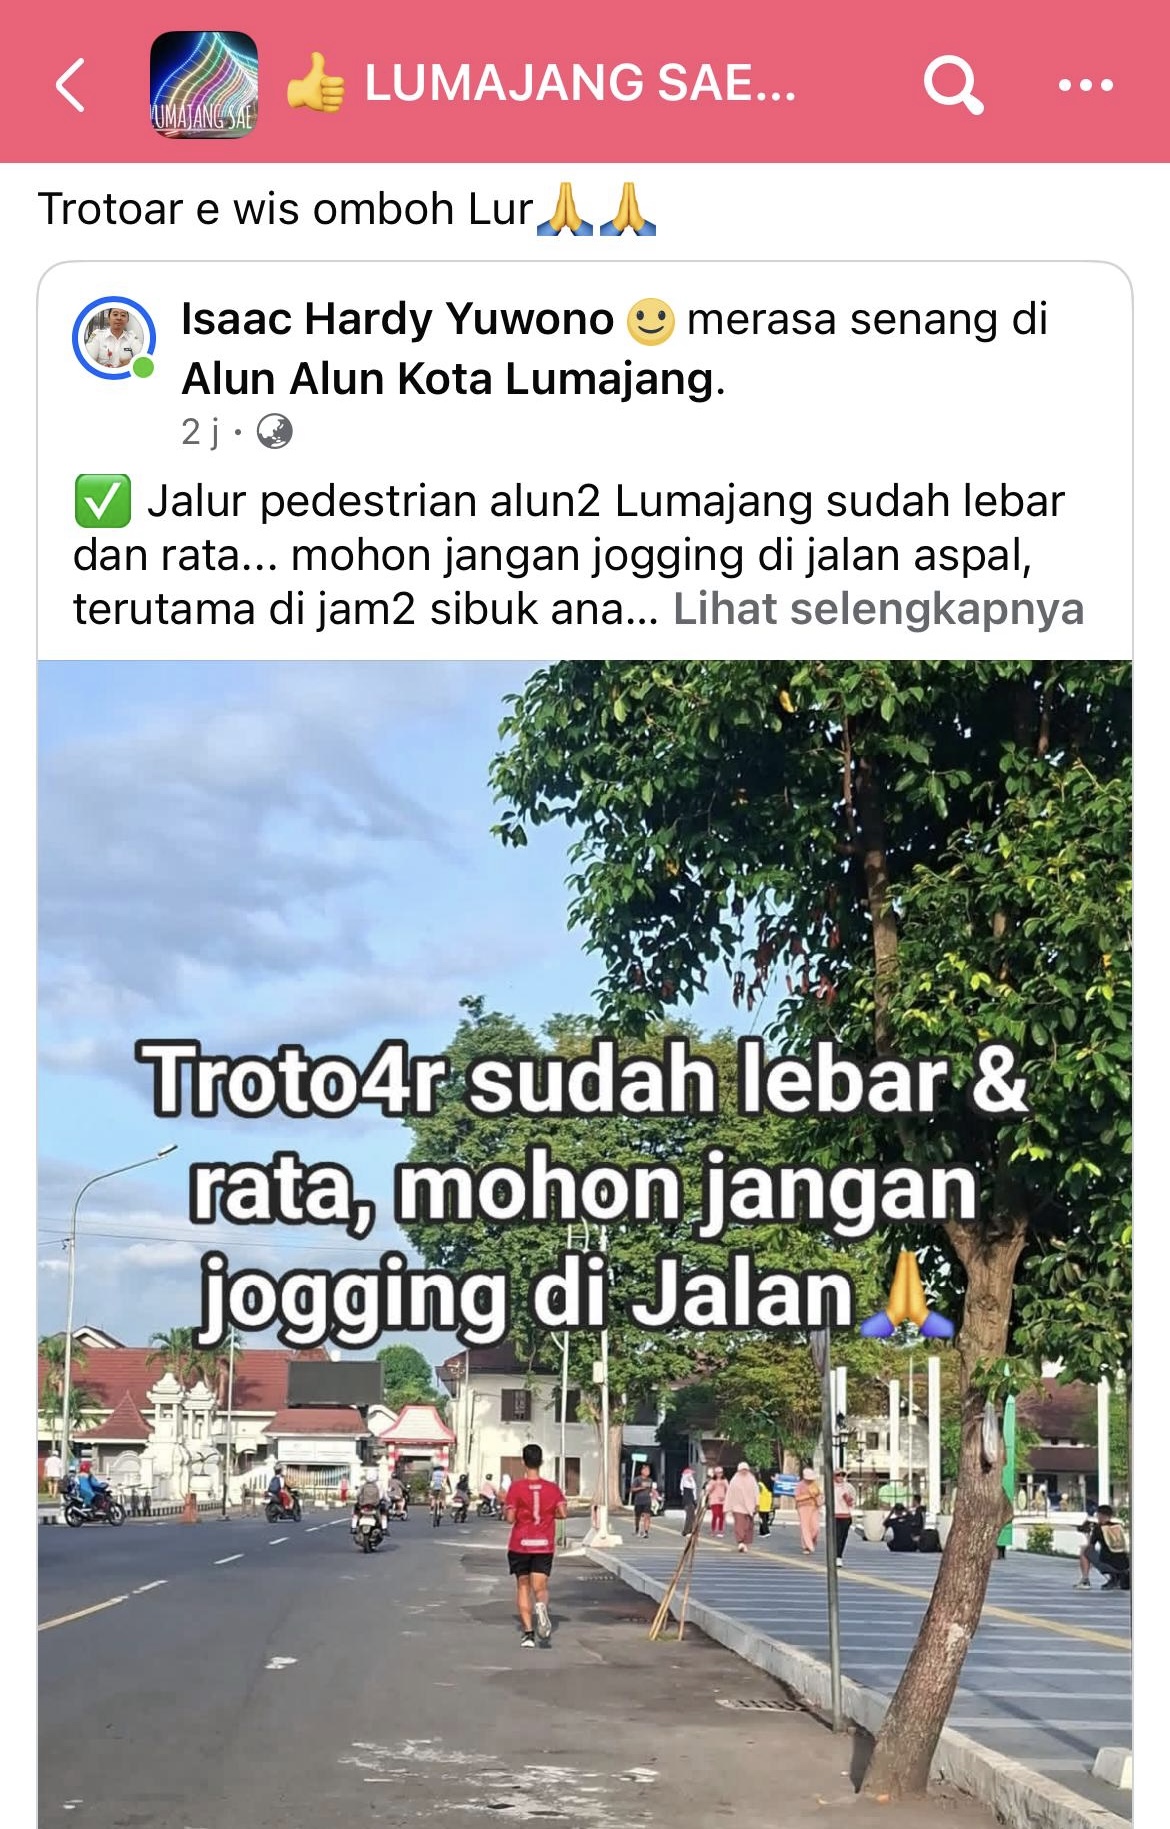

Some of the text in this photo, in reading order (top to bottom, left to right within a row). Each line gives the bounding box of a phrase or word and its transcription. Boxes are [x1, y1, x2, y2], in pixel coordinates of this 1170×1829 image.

[367, 62, 795, 102] LUMAJANG SAE...
[228, 104, 252, 129] SAE
[37, 190, 534, 225] Trotoar e wis omboh Lur
[183, 300, 1047, 343] Isaac Hardy Yuwono merasa senang di
[181, 359, 725, 403] Alun Alun Kota Lumajang.
[182, 416, 218, 451] 2 j
[147, 482, 1066, 525] Jalur pedestrian alun2 Lumajang sudah lebar
[73, 536, 1031, 579] dan rata... mohon jangan jogging di jalan aspal,
[72, 589, 1084, 633] terutama di jam2 sibuk ana... Lihat selengkapnya
